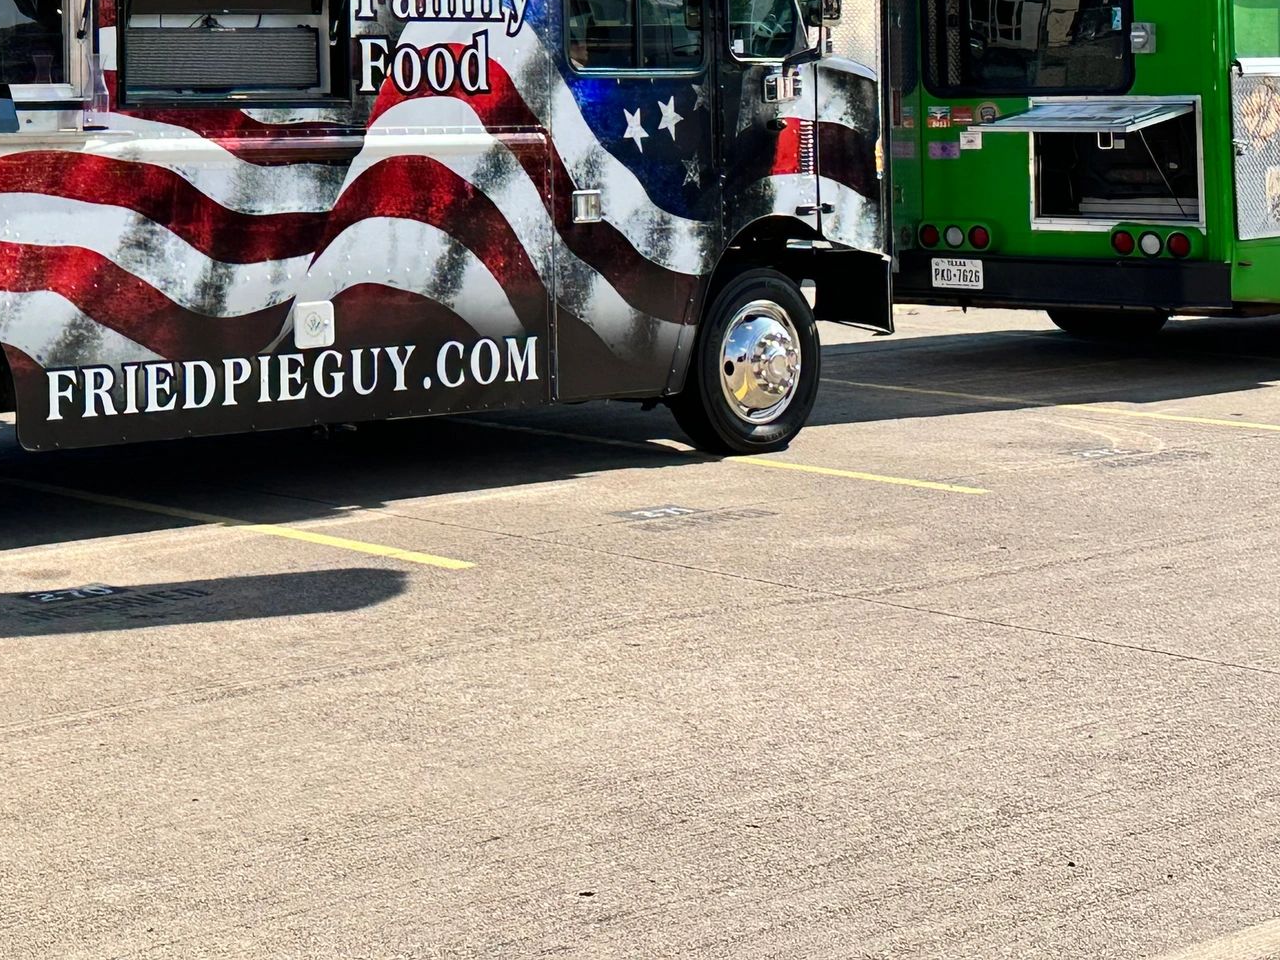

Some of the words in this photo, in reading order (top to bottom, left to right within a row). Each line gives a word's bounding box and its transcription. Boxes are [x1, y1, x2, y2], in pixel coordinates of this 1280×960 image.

[359, 34, 489, 92] Food
[46, 336, 540, 421] FRIEDPIEGUY.COM
[29, 583, 113, 602] 270
